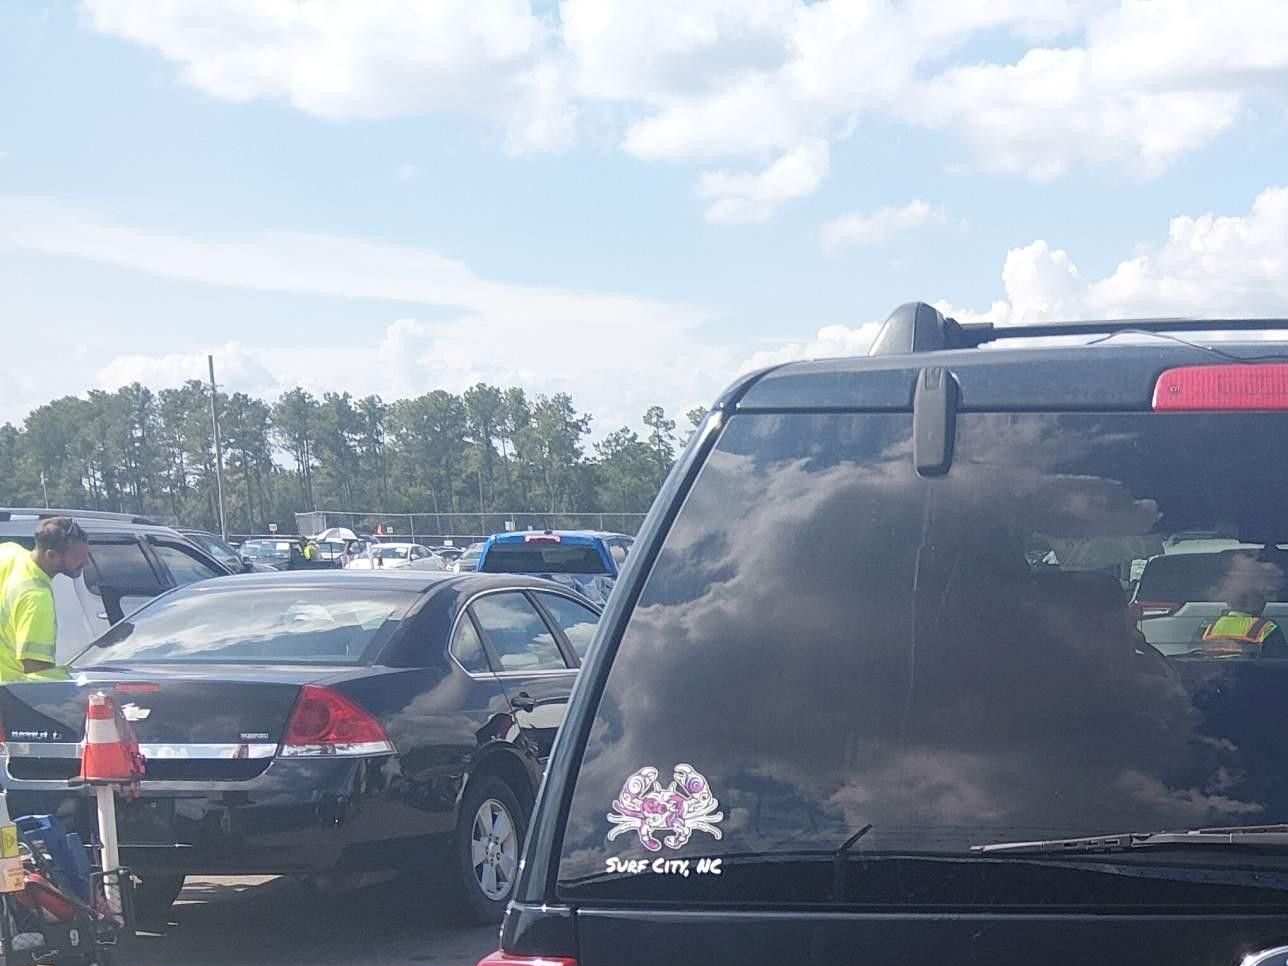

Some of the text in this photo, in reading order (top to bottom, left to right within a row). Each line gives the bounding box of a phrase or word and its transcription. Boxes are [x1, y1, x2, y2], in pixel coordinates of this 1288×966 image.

[605, 856, 722, 878] SURF CITY, NC
